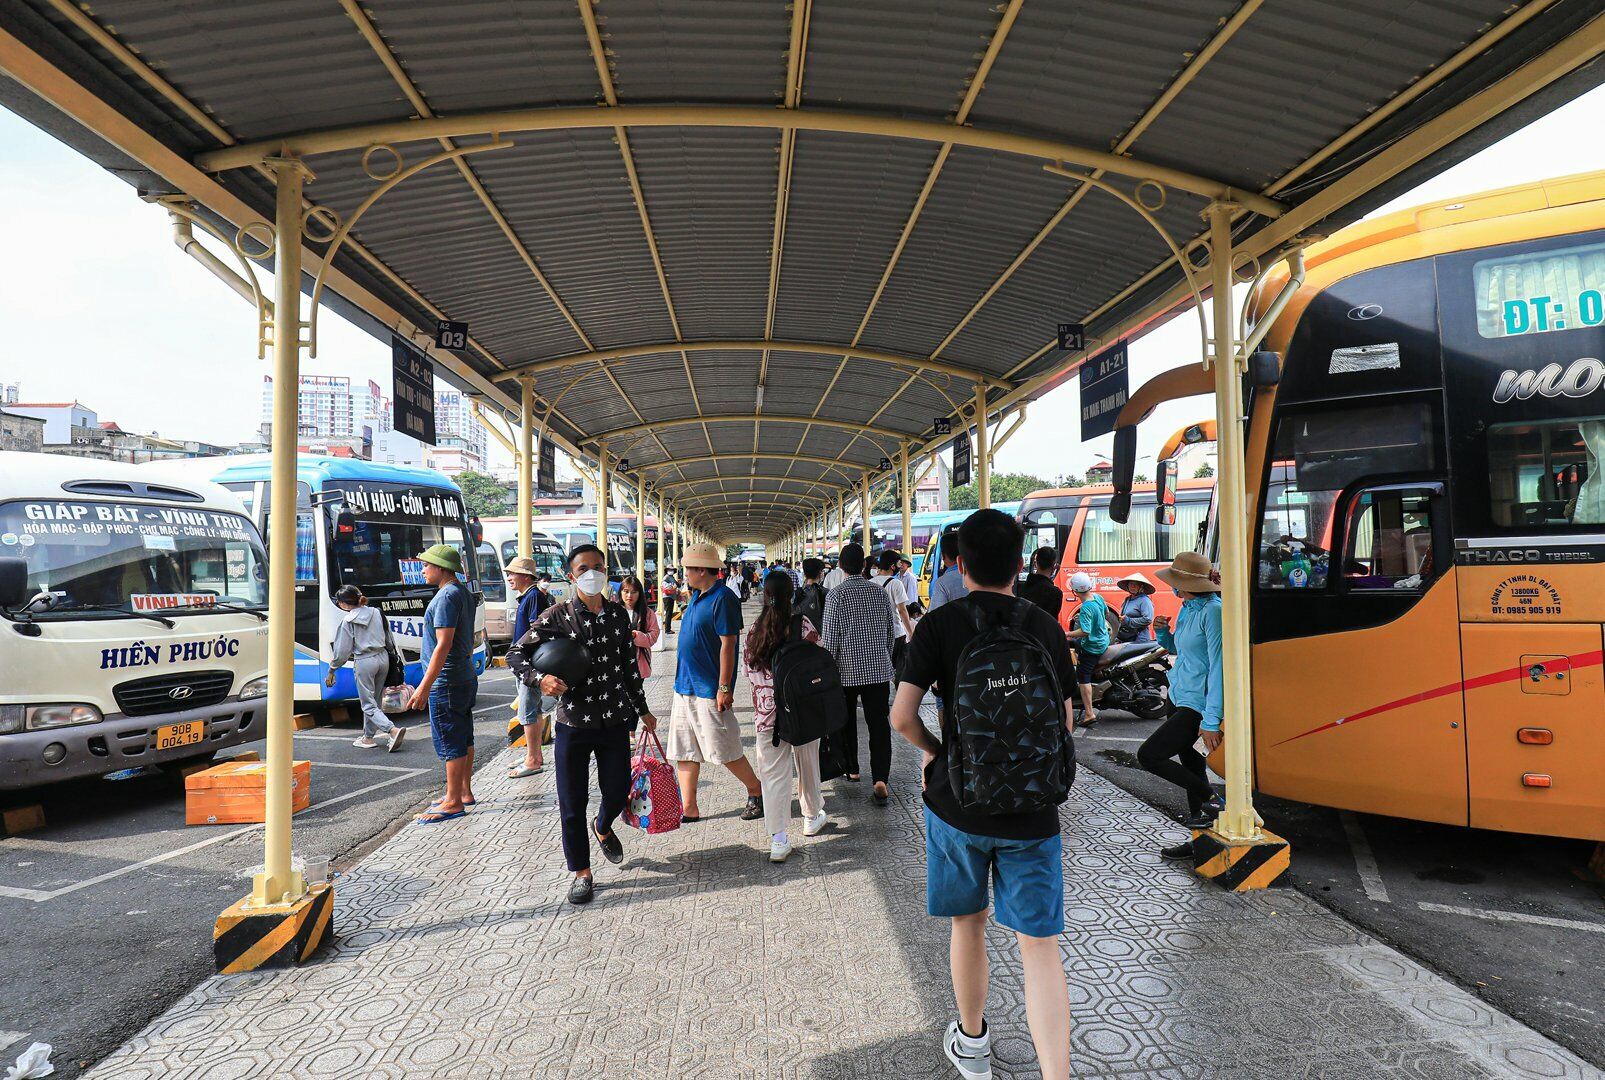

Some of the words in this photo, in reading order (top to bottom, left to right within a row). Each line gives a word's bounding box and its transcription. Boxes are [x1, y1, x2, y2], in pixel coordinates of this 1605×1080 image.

[1502, 295, 1566, 336] ĐT:
[440, 322, 450, 330] A2
[441, 331, 464, 348] 03
[1065, 333, 1081, 348] 21
[1100, 351, 1124, 376] A1-21
[1493, 357, 1605, 404] mo
[441, 394, 459, 406] MB
[937, 424, 949, 433] 22
[618, 463, 628, 471] 05
[345, 485, 369, 512] HẢI
[371, 489, 395, 516] HẬU
[401, 489, 424, 515] CỒN
[429, 494, 444, 517] HÀ
[444, 496, 460, 521] NỘI
[24, 502, 88, 520] GIÁP
[95, 504, 140, 523] BÁT
[160, 508, 208, 526] VĨNH
[210, 514, 243, 531] TRỤ
[23, 521, 49, 534] HÒA
[50, 523, 76, 536] MẠC
[82, 521, 103, 536] ĐẬP
[106, 522, 134, 534] PHÚC
[159, 525, 179, 537] MẠC
[183, 525, 205, 537] CÔNG
[207, 526, 215, 537] LÝ
[1459, 549, 1540, 562] THACO
[1491, 588, 1502, 605] CÔNG
[1499, 581, 1508, 589] TY
[1507, 575, 1527, 584] TNHH
[1528, 575, 1537, 583] DL
[1538, 579, 1551, 590] ĐẠI
[133, 594, 179, 610] VĨNH
[409, 599, 424, 609] LONG
[1492, 606, 1504, 614] ĐT:
[1506, 606, 1526, 614] 0985
[1528, 606, 1543, 614] 905
[1545, 606, 1561, 614] 919
[389, 617, 424, 638] HẢI
[100, 640, 161, 669] HIỀN
[168, 635, 239, 663] PHƯỚC
[987, 677, 1006, 691] Just
[1007, 675, 1019, 686] do
[1021, 674, 1027, 684] it
[171, 723, 192, 736] 90B
[162, 732, 199, 748] 004.19
